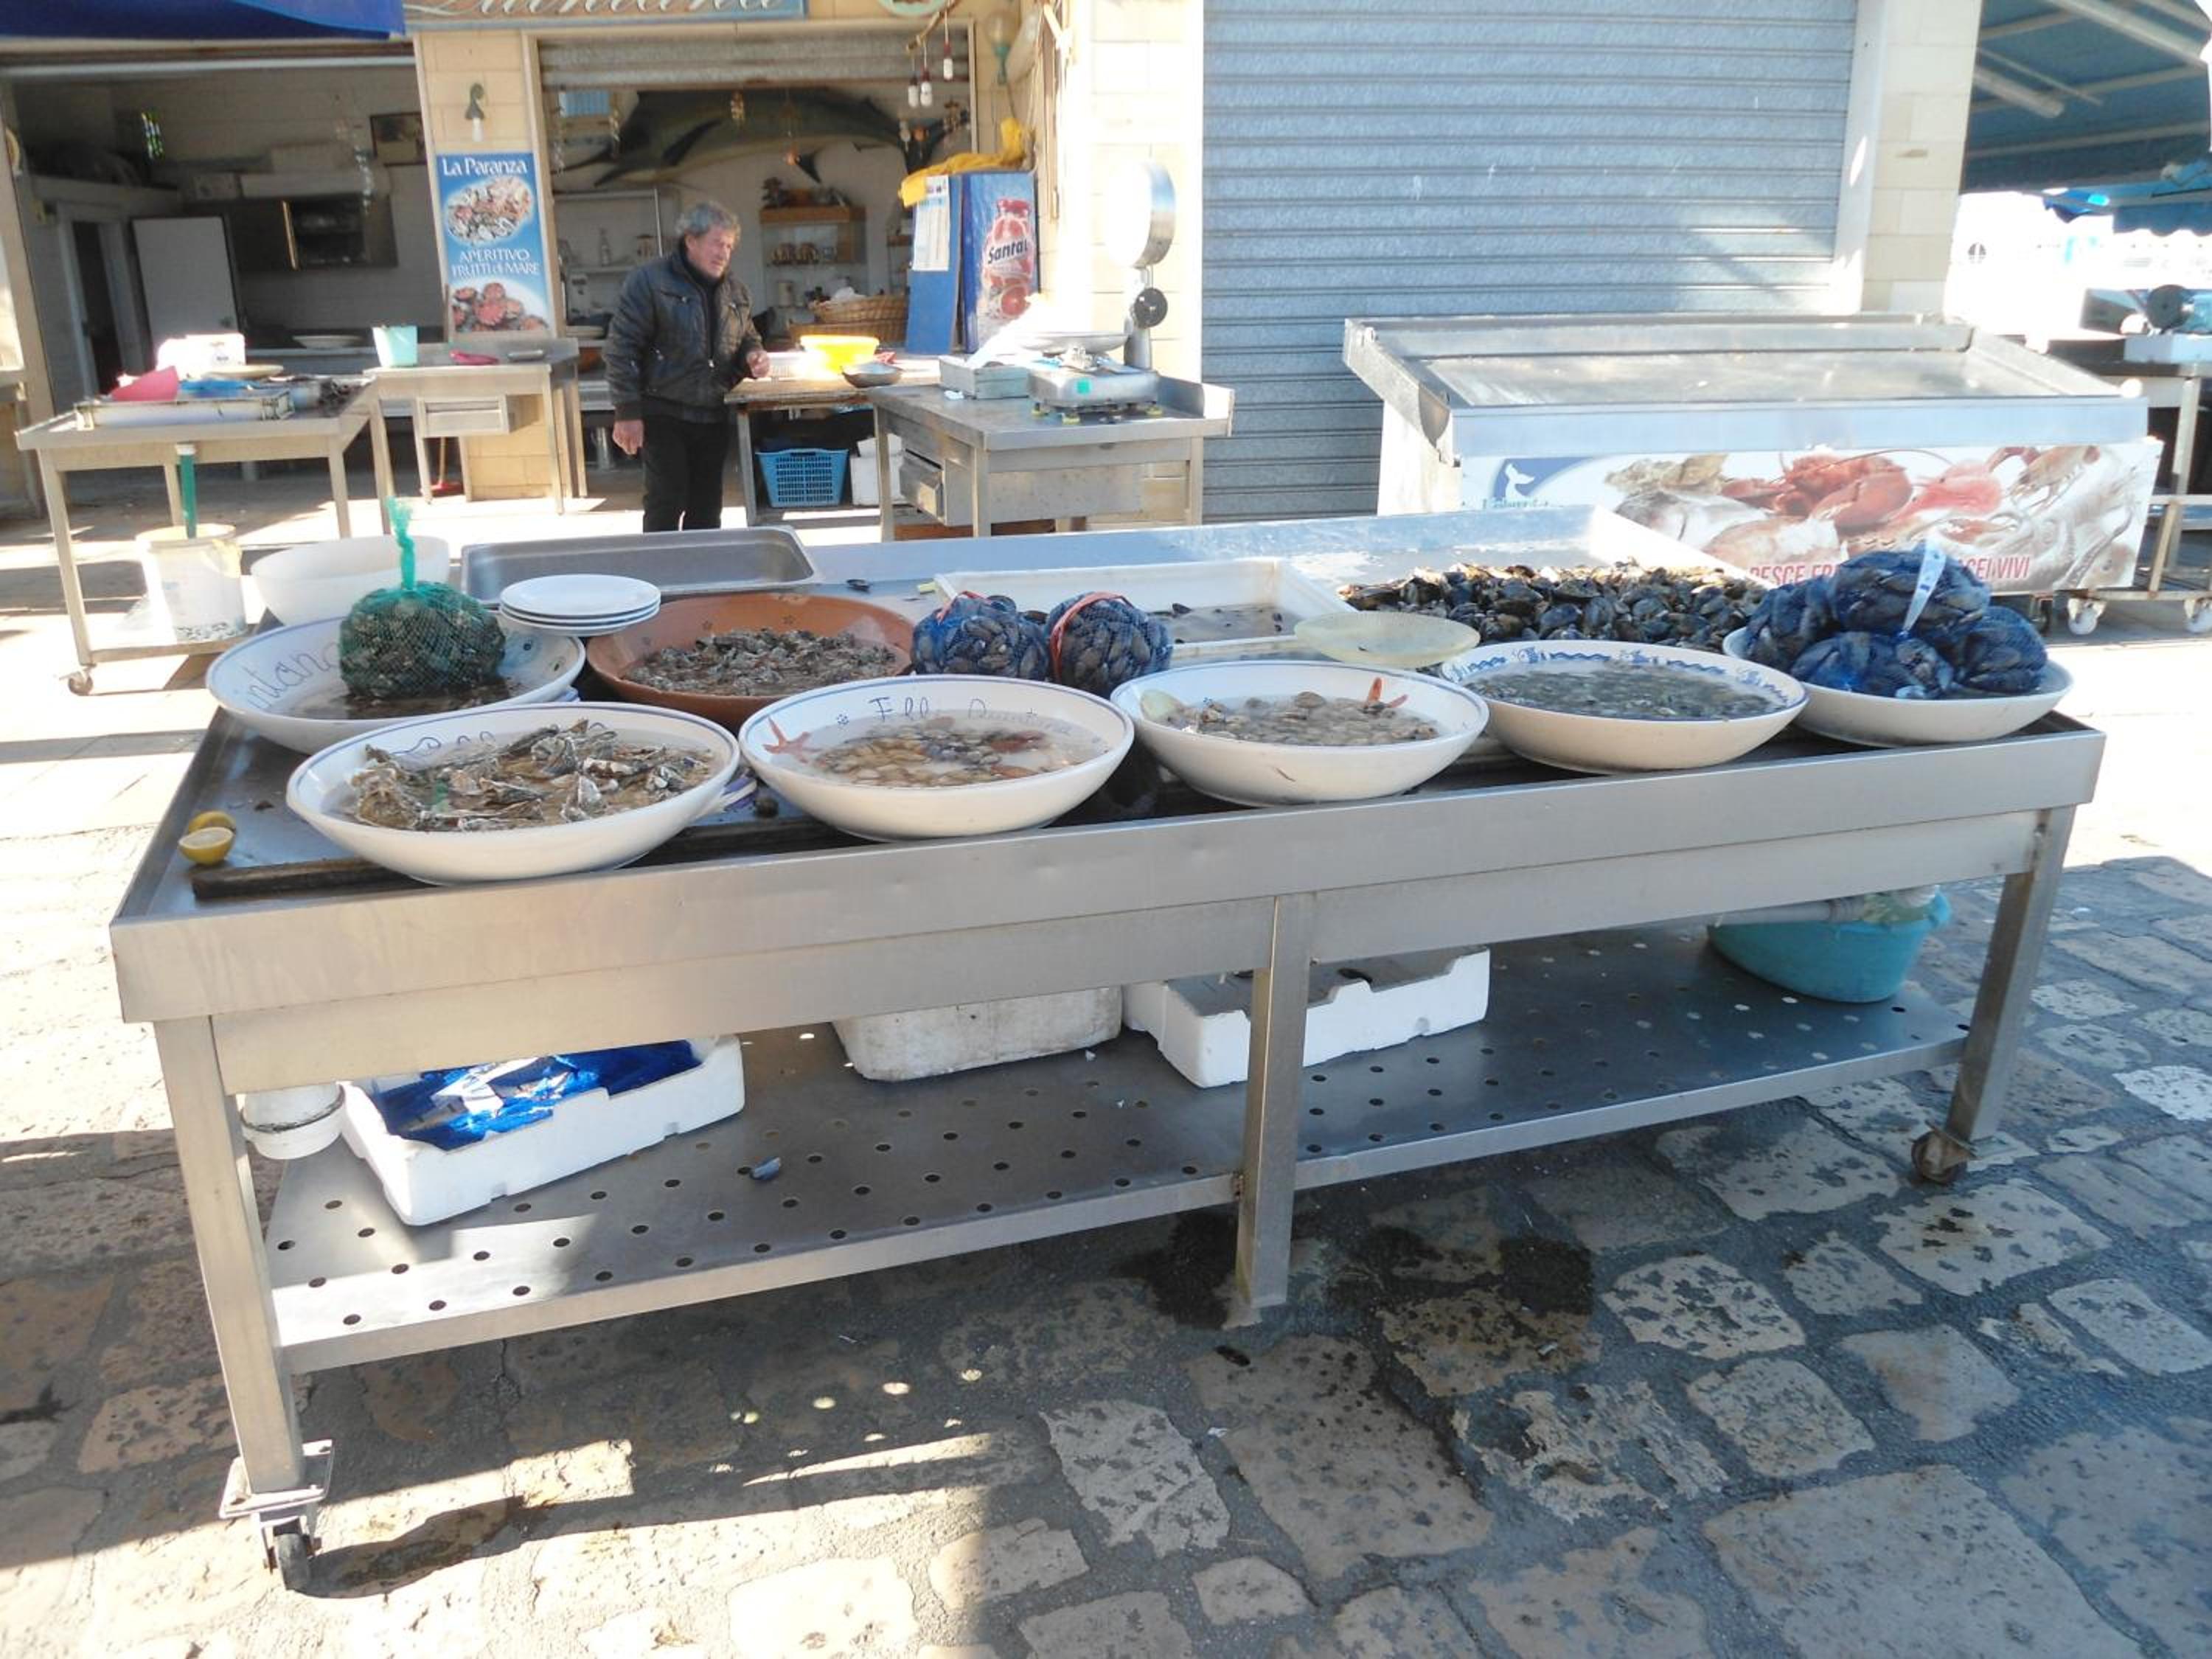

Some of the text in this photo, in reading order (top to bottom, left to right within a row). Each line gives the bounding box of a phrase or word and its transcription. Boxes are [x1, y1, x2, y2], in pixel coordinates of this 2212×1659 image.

[442, 156, 528, 176] La Paranza
[459, 248, 531, 262] APERITIVO
[987, 239, 1029, 265] Santal
[451, 263, 495, 278] FRUTTI
[504, 261, 540, 276] MARE
[1997, 557, 2030, 579] VIVI
